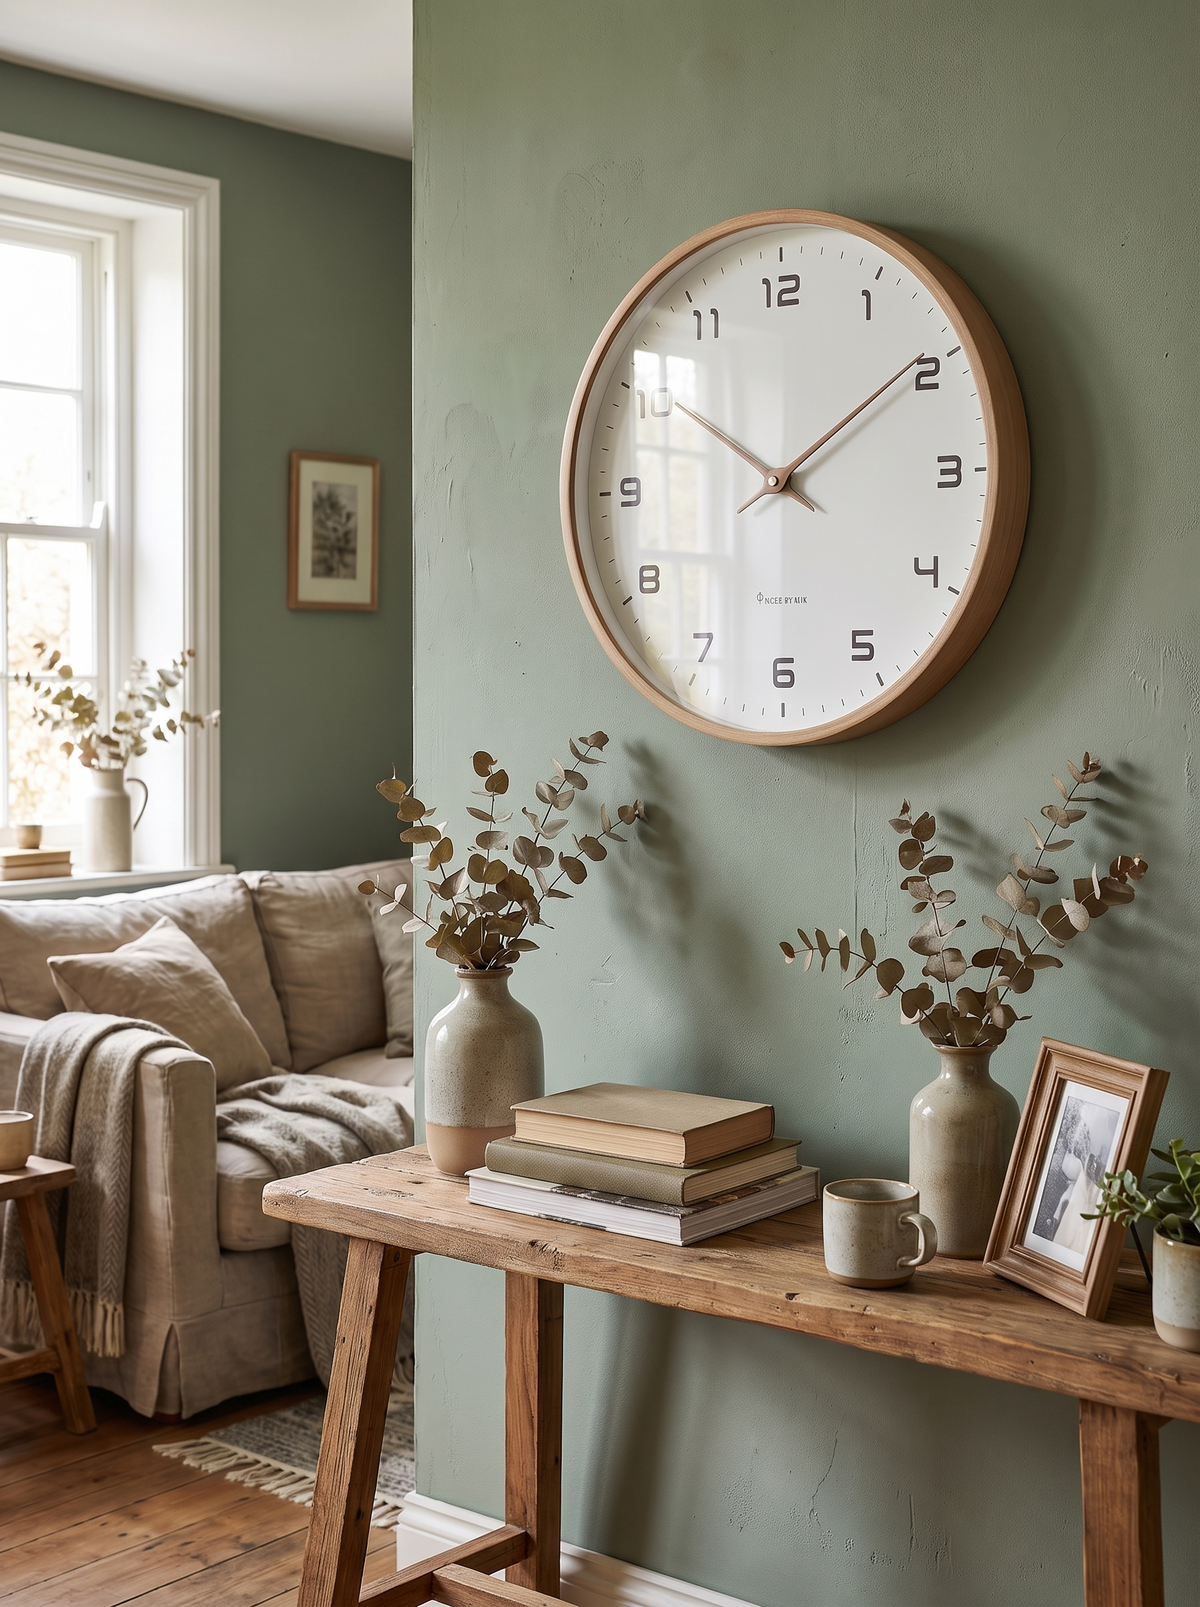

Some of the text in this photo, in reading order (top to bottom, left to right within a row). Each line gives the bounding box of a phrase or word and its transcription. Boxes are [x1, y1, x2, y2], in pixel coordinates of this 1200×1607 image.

[761, 274, 801, 308] 12
[861, 290, 872, 321] 1
[693, 308, 719, 341] 11
[914, 355, 941, 391] 2
[636, 387, 673, 419] 10
[937, 455, 962, 488] 3
[619, 477, 641, 507] 9
[639, 565, 660, 594] 8
[914, 556, 939, 588] 4
[692, 632, 713, 663] 7
[851, 630, 875, 661] 5
[772, 657, 795, 688] 6
